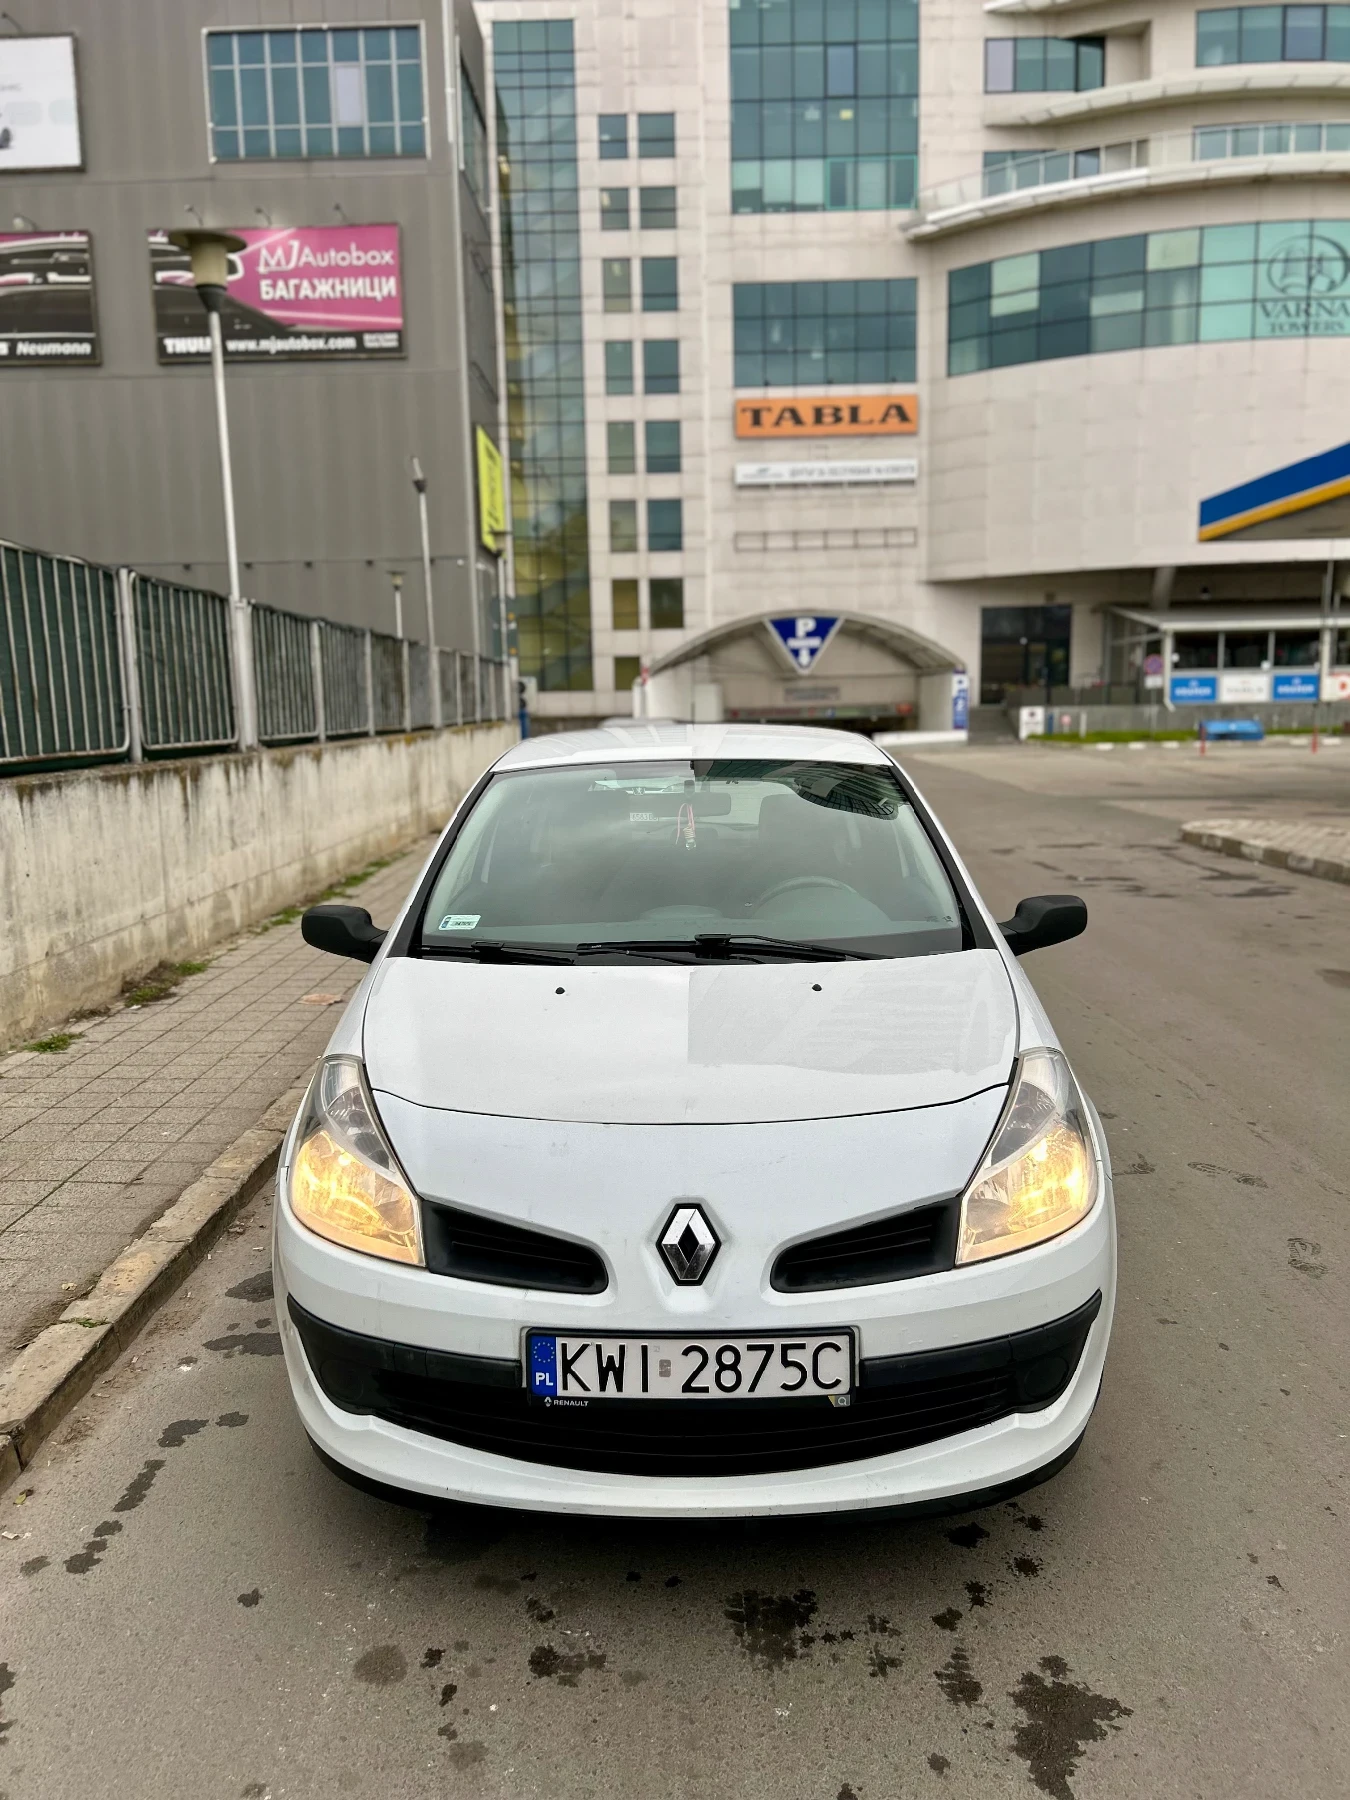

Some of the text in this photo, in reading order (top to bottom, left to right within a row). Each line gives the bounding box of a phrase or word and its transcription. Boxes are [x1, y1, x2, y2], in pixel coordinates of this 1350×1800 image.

[260, 276, 397, 301] БАГАЖНИЦИ
[16, 341, 91, 355] Neumann
[226, 335, 357, 354] www.mjautobox.com
[741, 404, 911, 427] TABLA
[795, 617, 816, 638] P
[560, 1341, 842, 1394] KWI 2875C
[535, 1372, 554, 1387] PL
[553, 1399, 589, 1407] RENAULT
